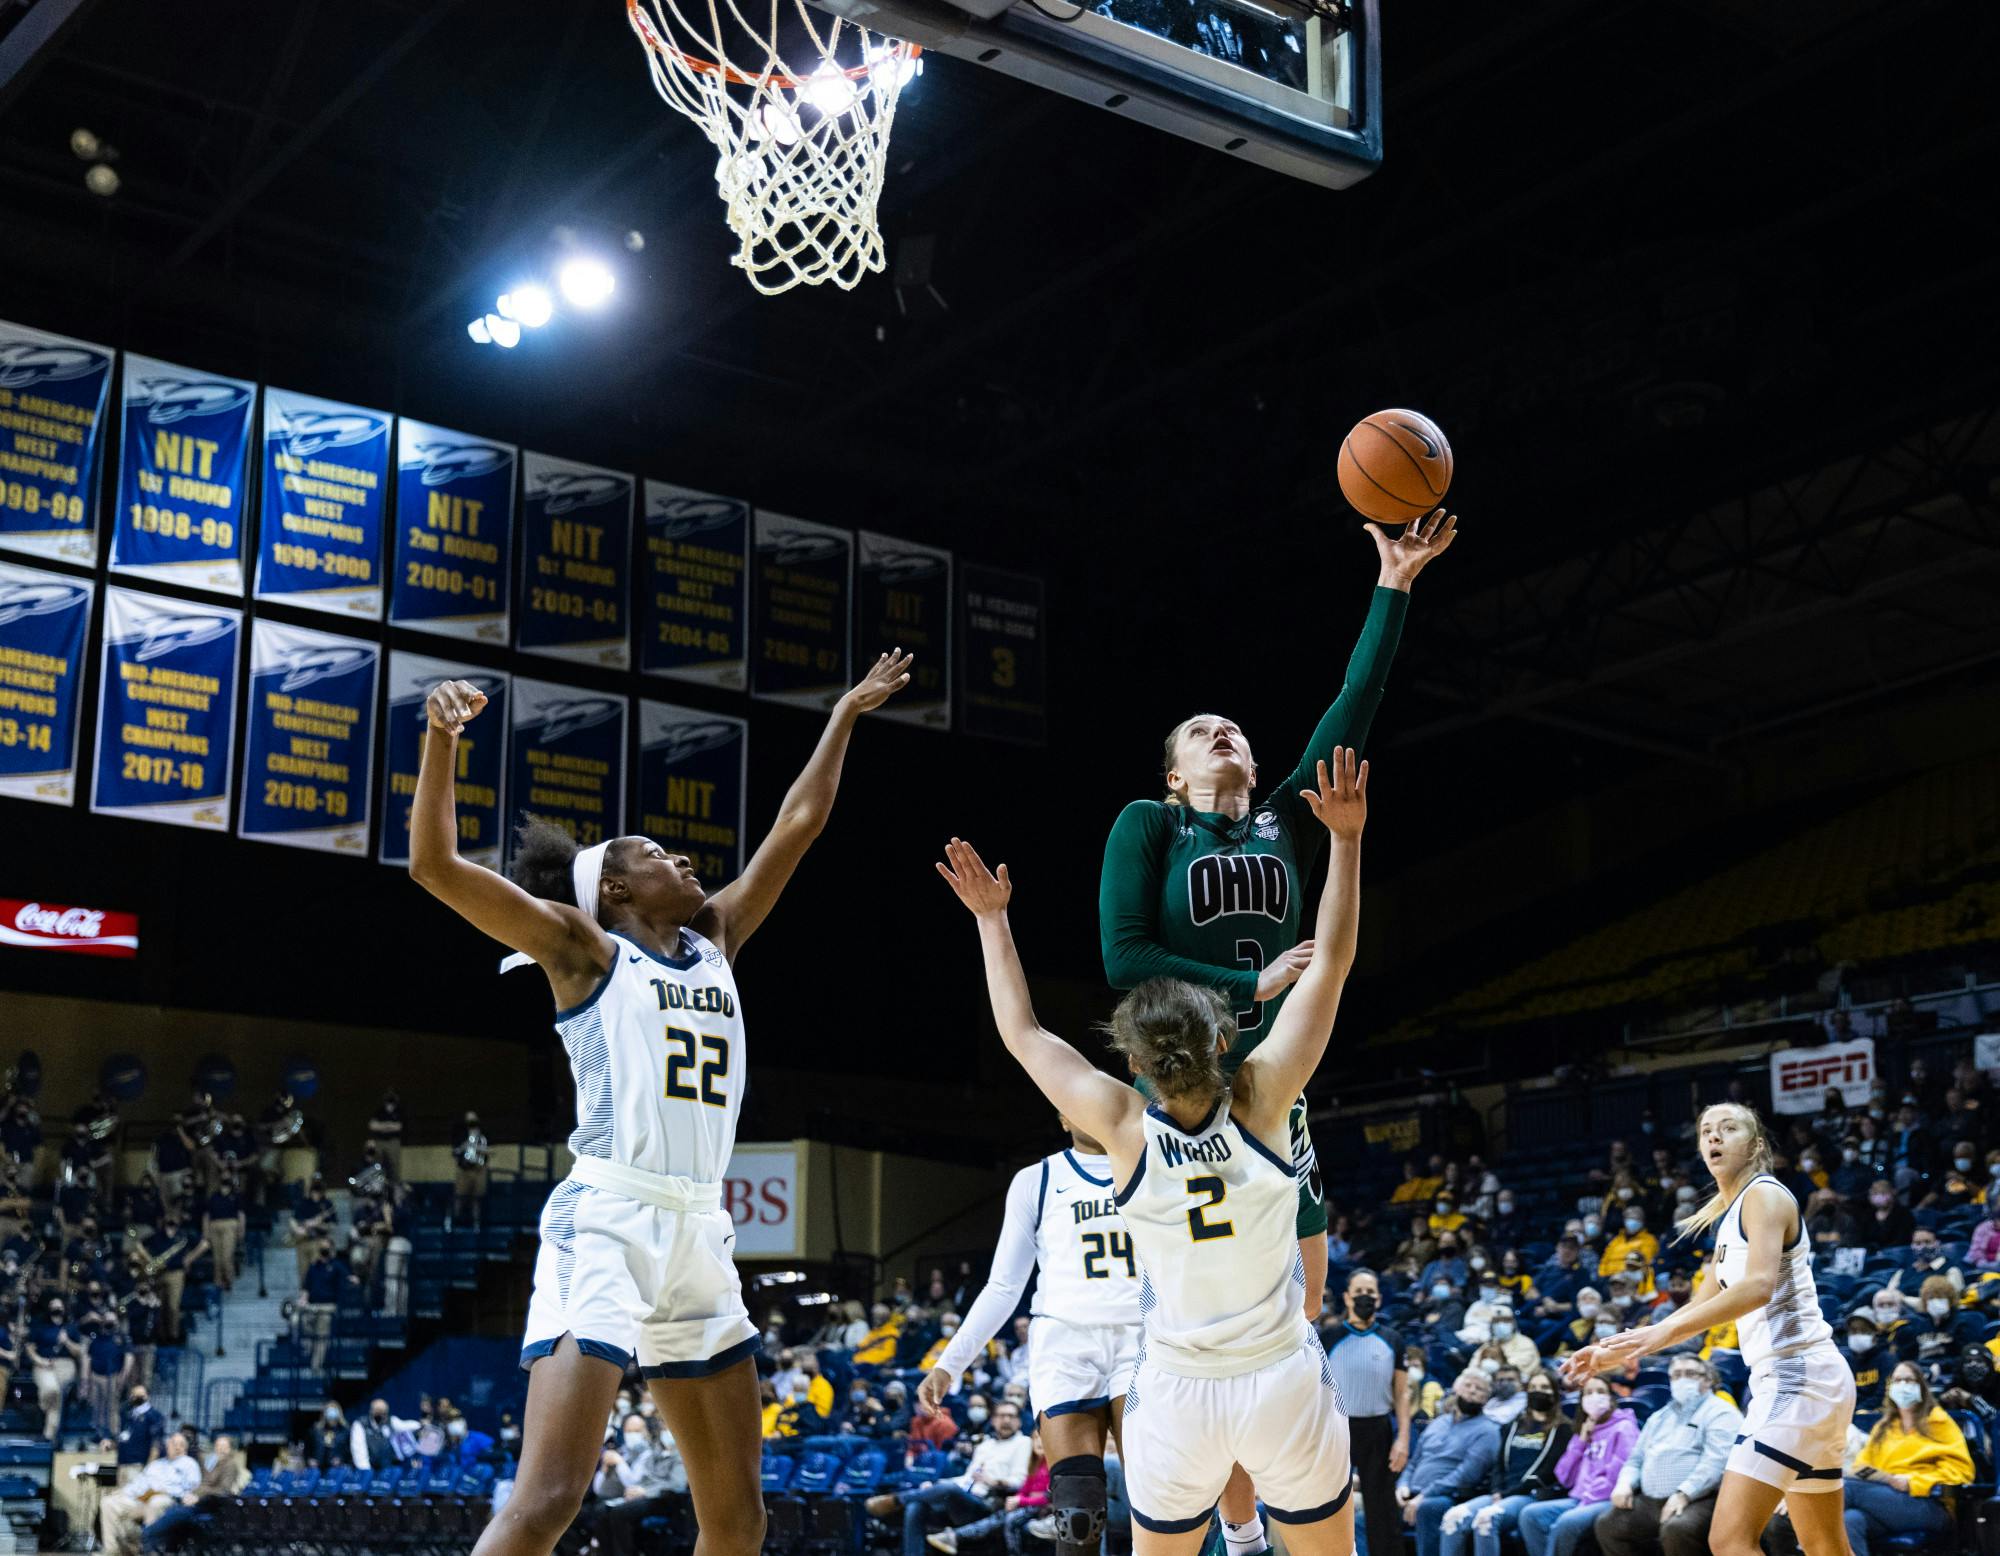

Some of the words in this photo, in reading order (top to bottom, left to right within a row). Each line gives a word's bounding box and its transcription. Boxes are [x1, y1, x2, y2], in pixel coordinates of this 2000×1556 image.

[155, 429, 219, 480] NIT
[169, 475, 232, 509] ROUND
[304, 497, 343, 521] WEST
[129, 502, 234, 549] 1998-99
[282, 512, 364, 544] CHAMPIONS
[427, 490, 484, 537] NIT
[443, 535, 498, 564] ROUND
[551, 519, 604, 561] NIT
[272, 542, 371, 580] 1999-2000
[565, 562, 615, 587] ROUND
[406, 561, 497, 601] 2000-01
[532, 586, 617, 624] 2003-04
[121, 661, 220, 695] MID-AMERICAN
[991, 645, 1018, 689] 3
[127, 681, 211, 712] CONFERENCE
[266, 691, 360, 724] MID-AMERICAN
[146, 707, 189, 732] WEST
[273, 711, 350, 740] CONFERENCE
[122, 723, 210, 757] CHAMPIONS
[290, 736, 330, 760] WEST
[122, 751, 205, 791] 2017-18
[267, 752, 350, 784] CHAMPIONS
[263, 779, 349, 817] 2018-19
[455, 781, 496, 810] OUND
[666, 773, 717, 820] NIT
[642, 813, 685, 840] FIRST
[686, 822, 737, 849] ROUND
[1187, 853, 1290, 927] OHIO
[649, 976, 736, 1018] TOLEDO
[664, 1024, 730, 1109] 22
[1780, 1052, 1869, 1092] ESPN
[1185, 1175, 1235, 1243] 2
[1081, 1230, 1137, 1280] 24
